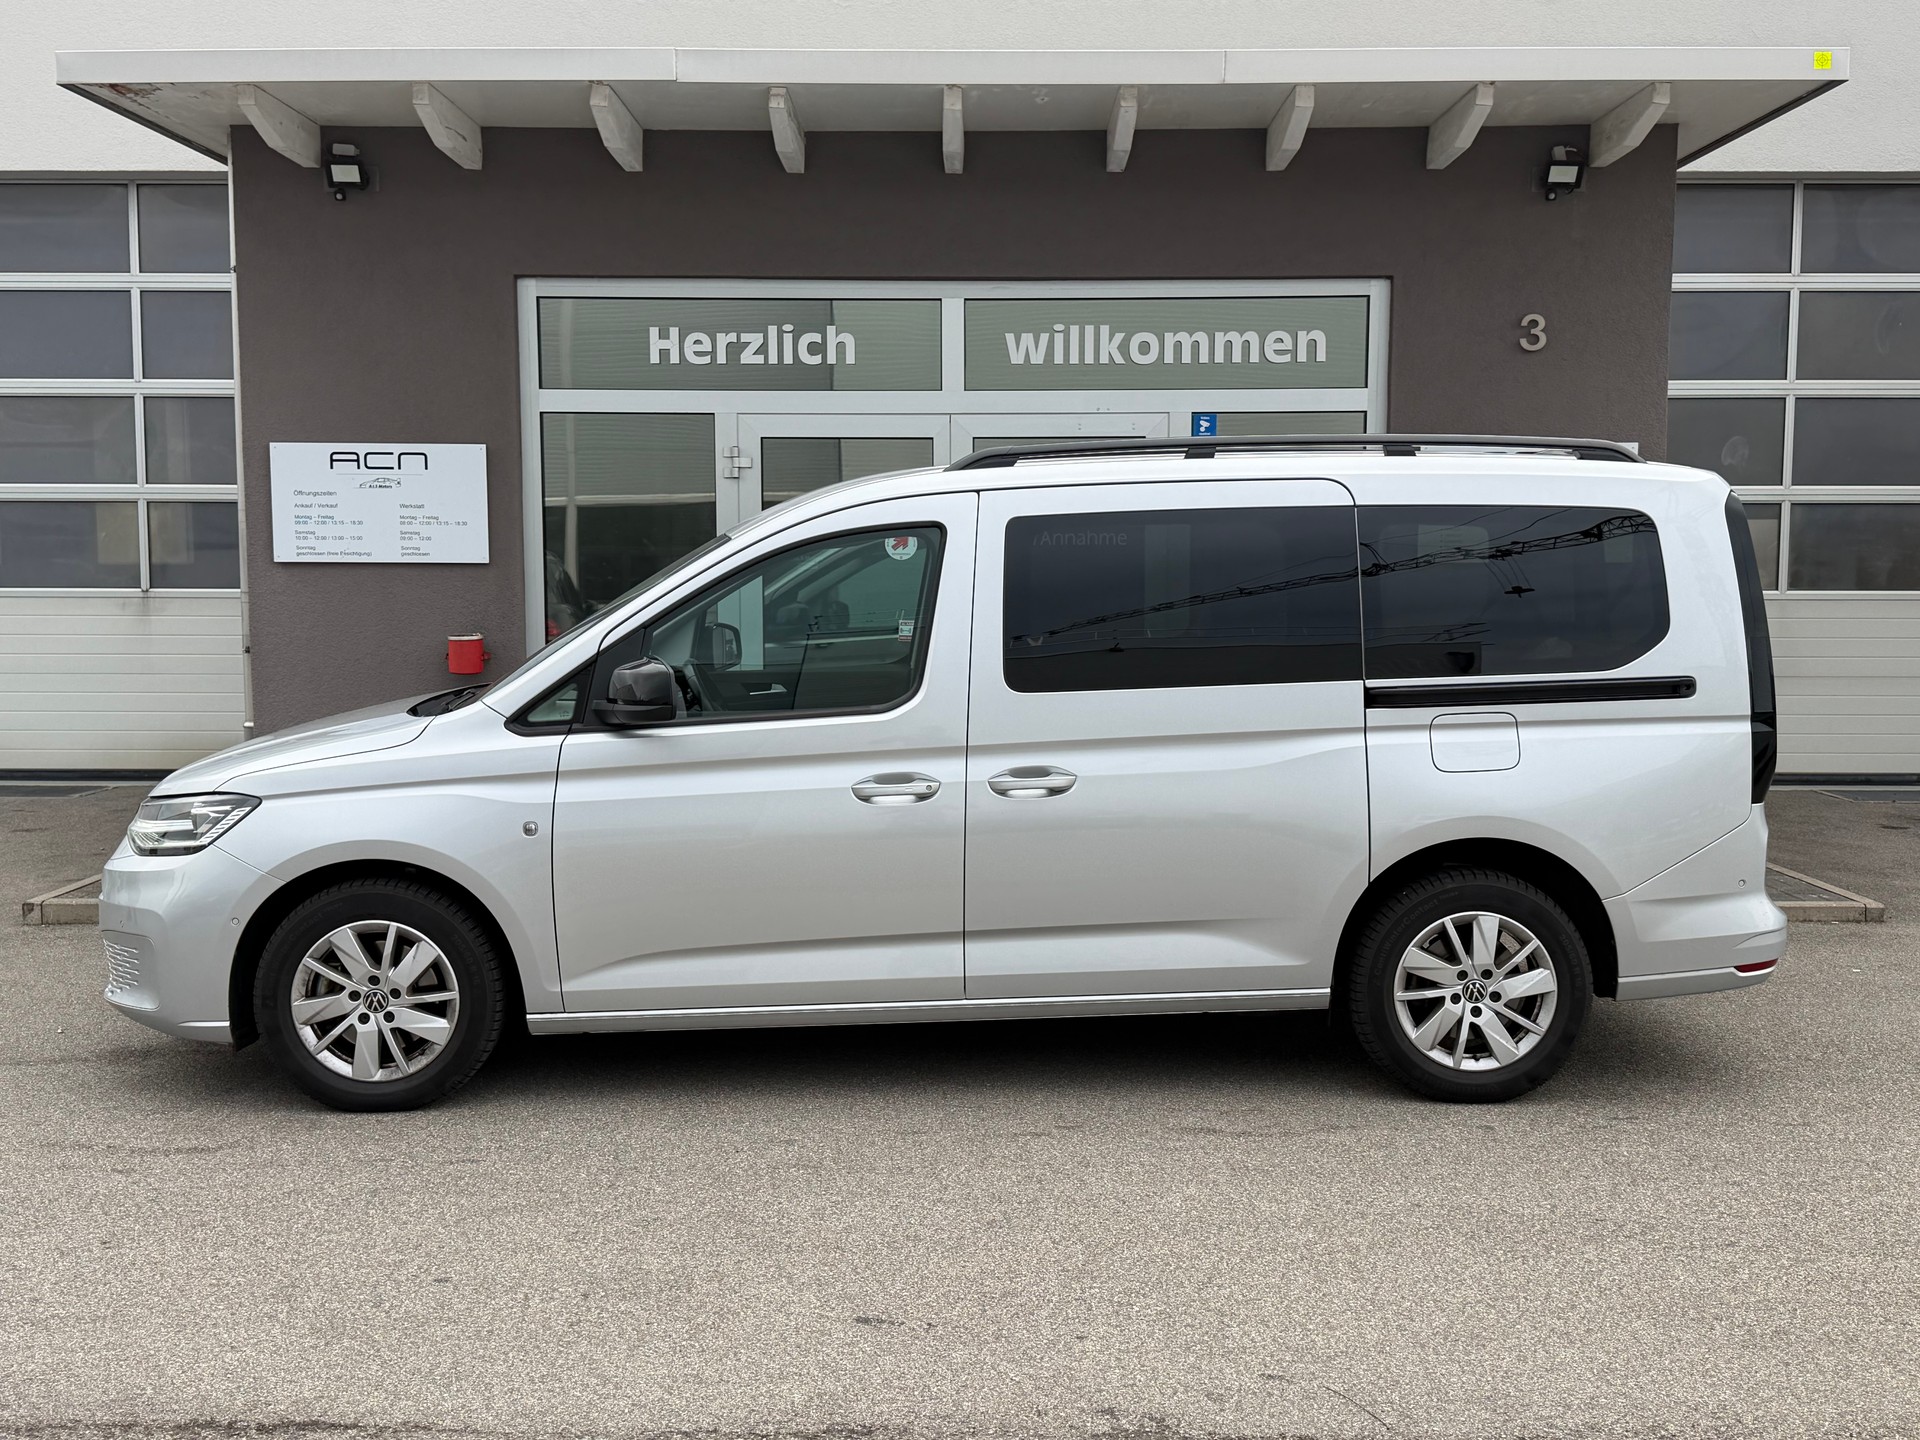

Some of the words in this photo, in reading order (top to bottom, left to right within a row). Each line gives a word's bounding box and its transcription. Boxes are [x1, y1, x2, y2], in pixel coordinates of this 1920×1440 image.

[649, 324, 856, 365] Herzlich
[1004, 323, 1327, 365] willkommen
[1519, 313, 1547, 351] 3
[293, 489, 337, 497] Öffnungszeiten
[1040, 530, 1128, 546] Annahme
